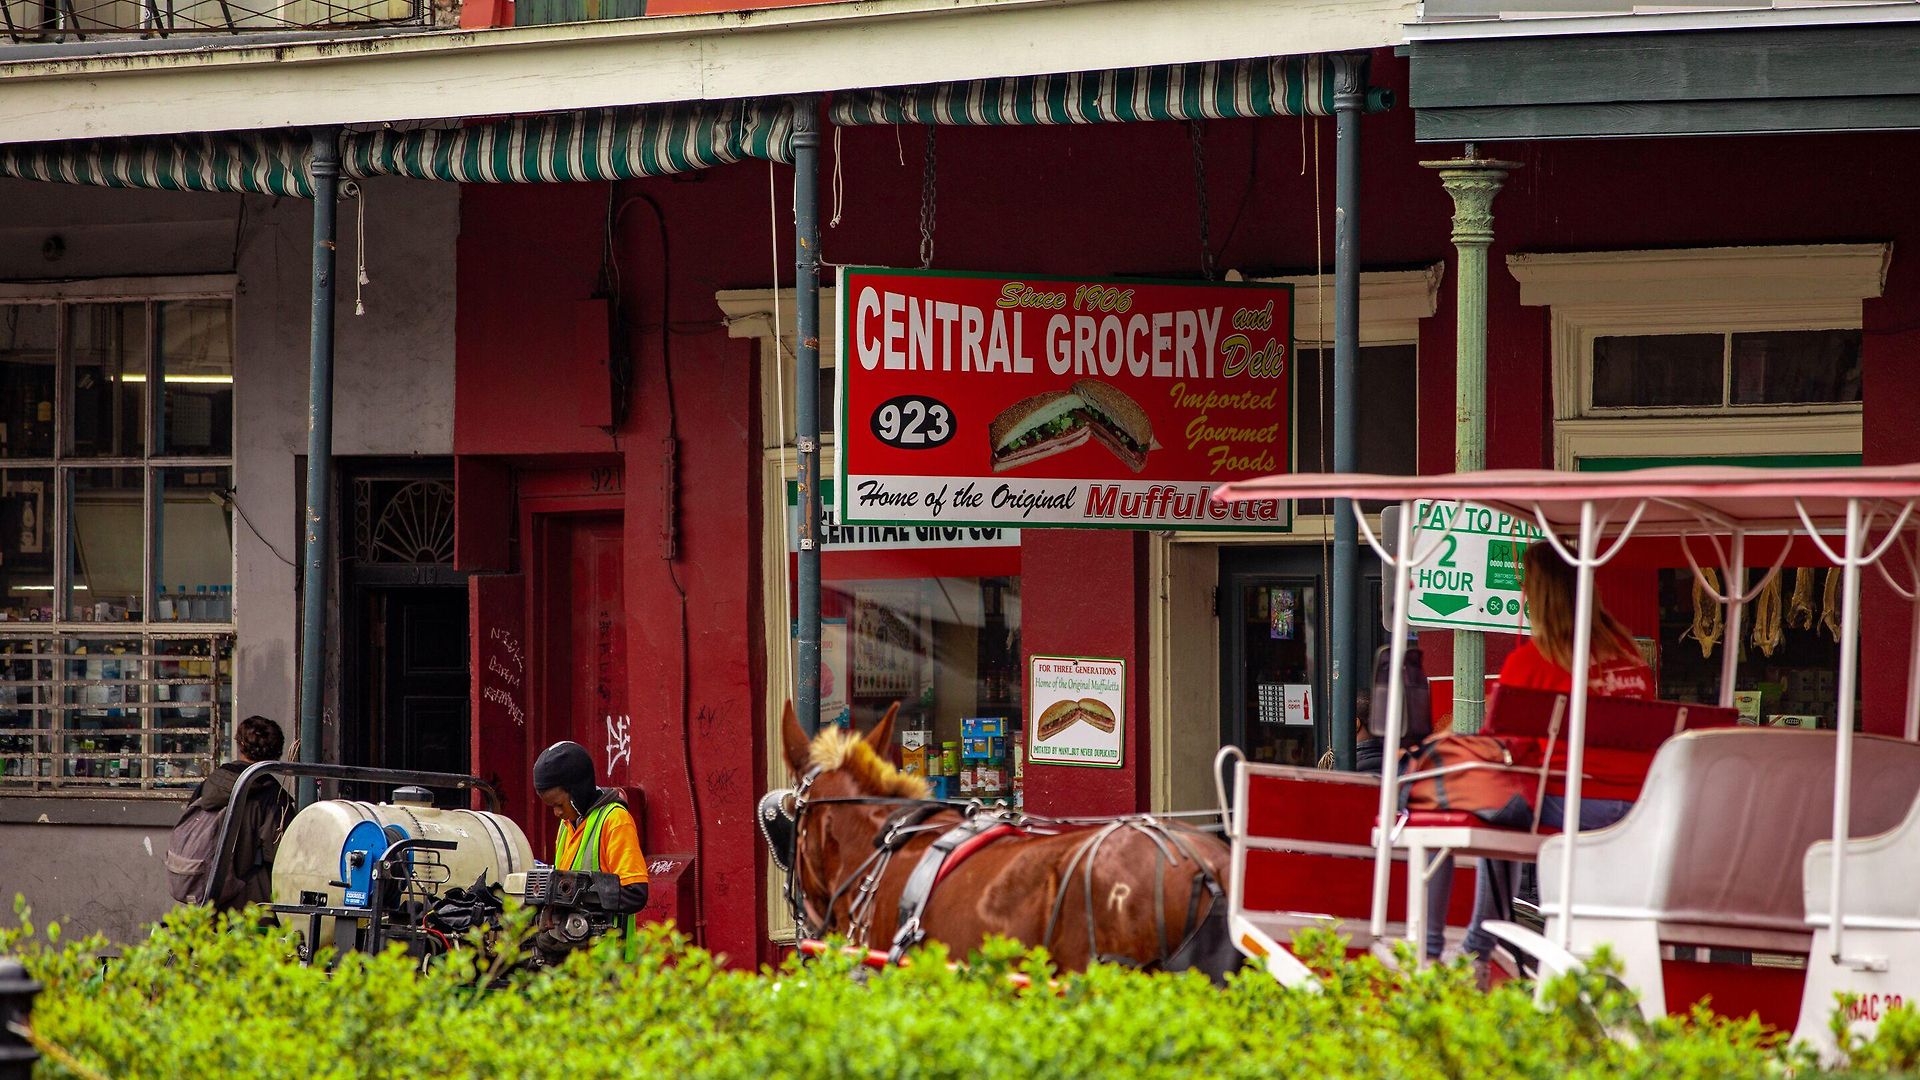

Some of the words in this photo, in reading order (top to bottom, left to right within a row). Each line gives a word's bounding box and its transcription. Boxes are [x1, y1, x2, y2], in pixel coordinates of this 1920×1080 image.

[996, 282, 1066, 310] Since
[1073, 285, 1135, 313] 1906
[1232, 300, 1274, 331] and
[856, 286, 1033, 373] CENTRAL
[1046, 307, 1223, 378] GROCERY
[1221, 334, 1284, 378] Deli
[1170, 382, 1277, 414] Imported
[878, 401, 950, 443] 923
[1186, 415, 1278, 450] Gourmet
[1207, 445, 1276, 475] Foods
[857, 480, 919, 507] Home
[925, 484, 948, 517] of
[952, 482, 983, 508] the
[992, 483, 1077, 518] Original
[1084, 484, 1280, 520] Muffuletta
[1418, 503, 1459, 529] PAY
[1465, 507, 1492, 534] TO
[1437, 534, 1457, 568] 2
[1419, 569, 1474, 592] HOUR
[1035, 677, 1051, 689] Home
[1068, 678, 1090, 693] Original
[1039, 664, 1051, 673] FOR
[1054, 665, 1073, 674] THREE
[1075, 666, 1117, 676] GENERATIONS
